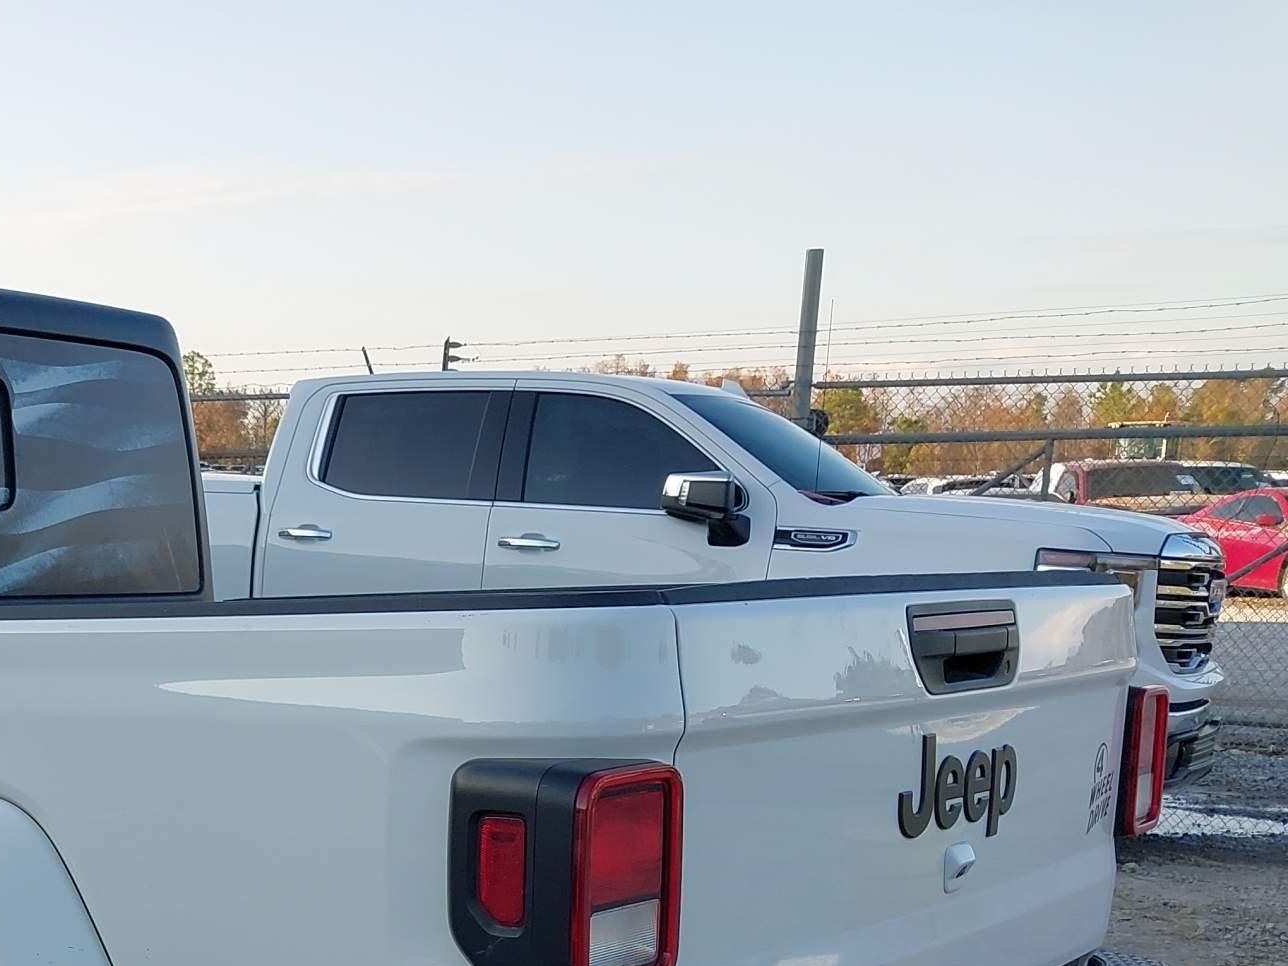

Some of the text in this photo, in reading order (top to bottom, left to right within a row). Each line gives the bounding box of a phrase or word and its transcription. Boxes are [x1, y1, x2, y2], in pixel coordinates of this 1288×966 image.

[898, 733, 1017, 838] Jeep
[1089, 772, 1113, 809] WHEEL
[1086, 795, 1111, 834] DRIVE
